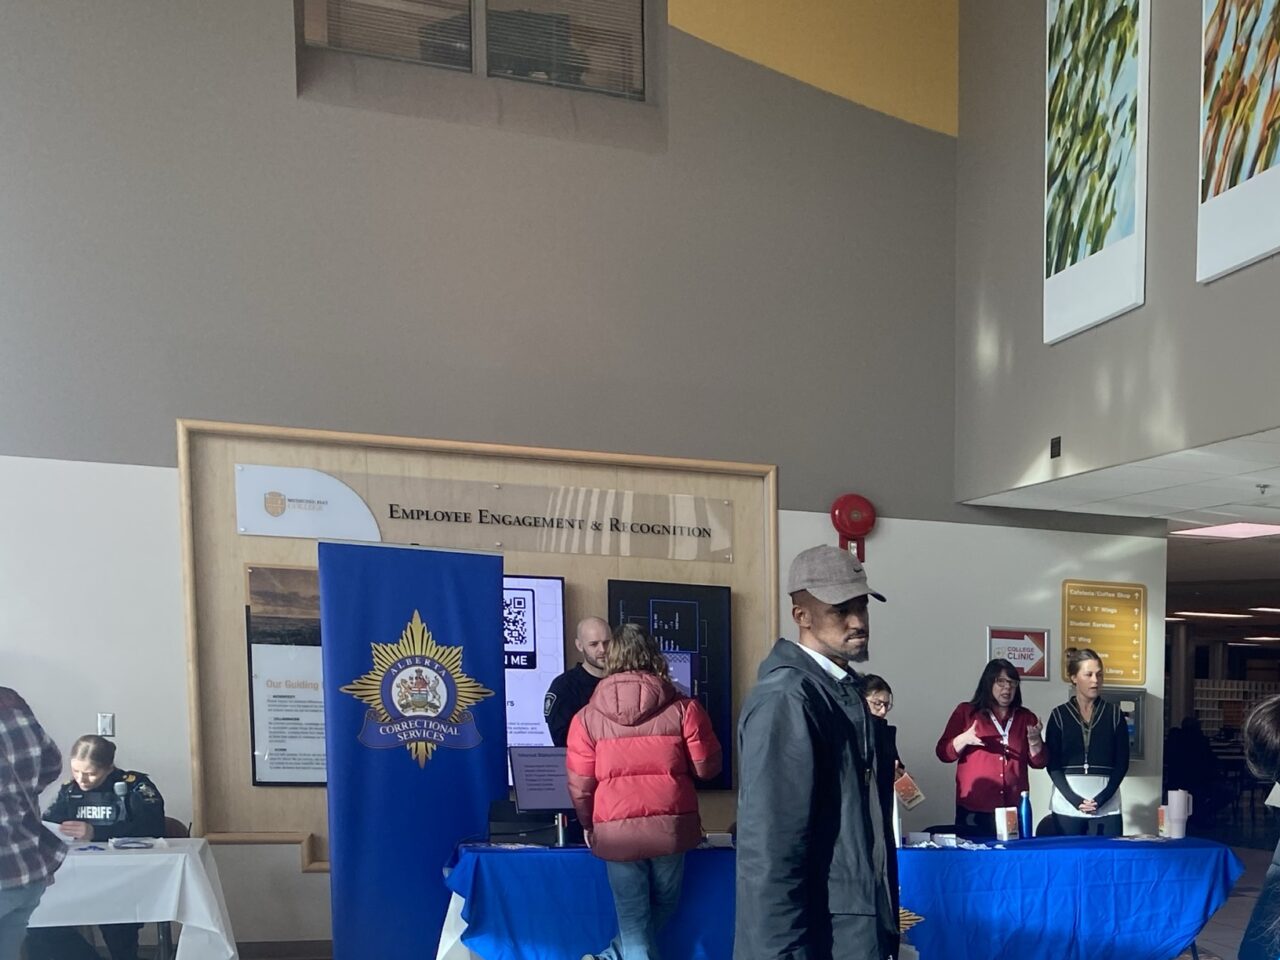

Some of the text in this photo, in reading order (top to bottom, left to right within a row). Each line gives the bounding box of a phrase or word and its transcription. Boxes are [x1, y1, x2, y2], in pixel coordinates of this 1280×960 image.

[510, 655, 528, 666] ME
[1007, 652, 1035, 661] CLINIC
[389, 656, 447, 677] ALBERTA
[266, 679, 320, 691] Our Guiding
[379, 719, 460, 736] CORRECTIONAL
[396, 727, 445, 742] SERVICES
[76, 805, 113, 819] SHERIFF
